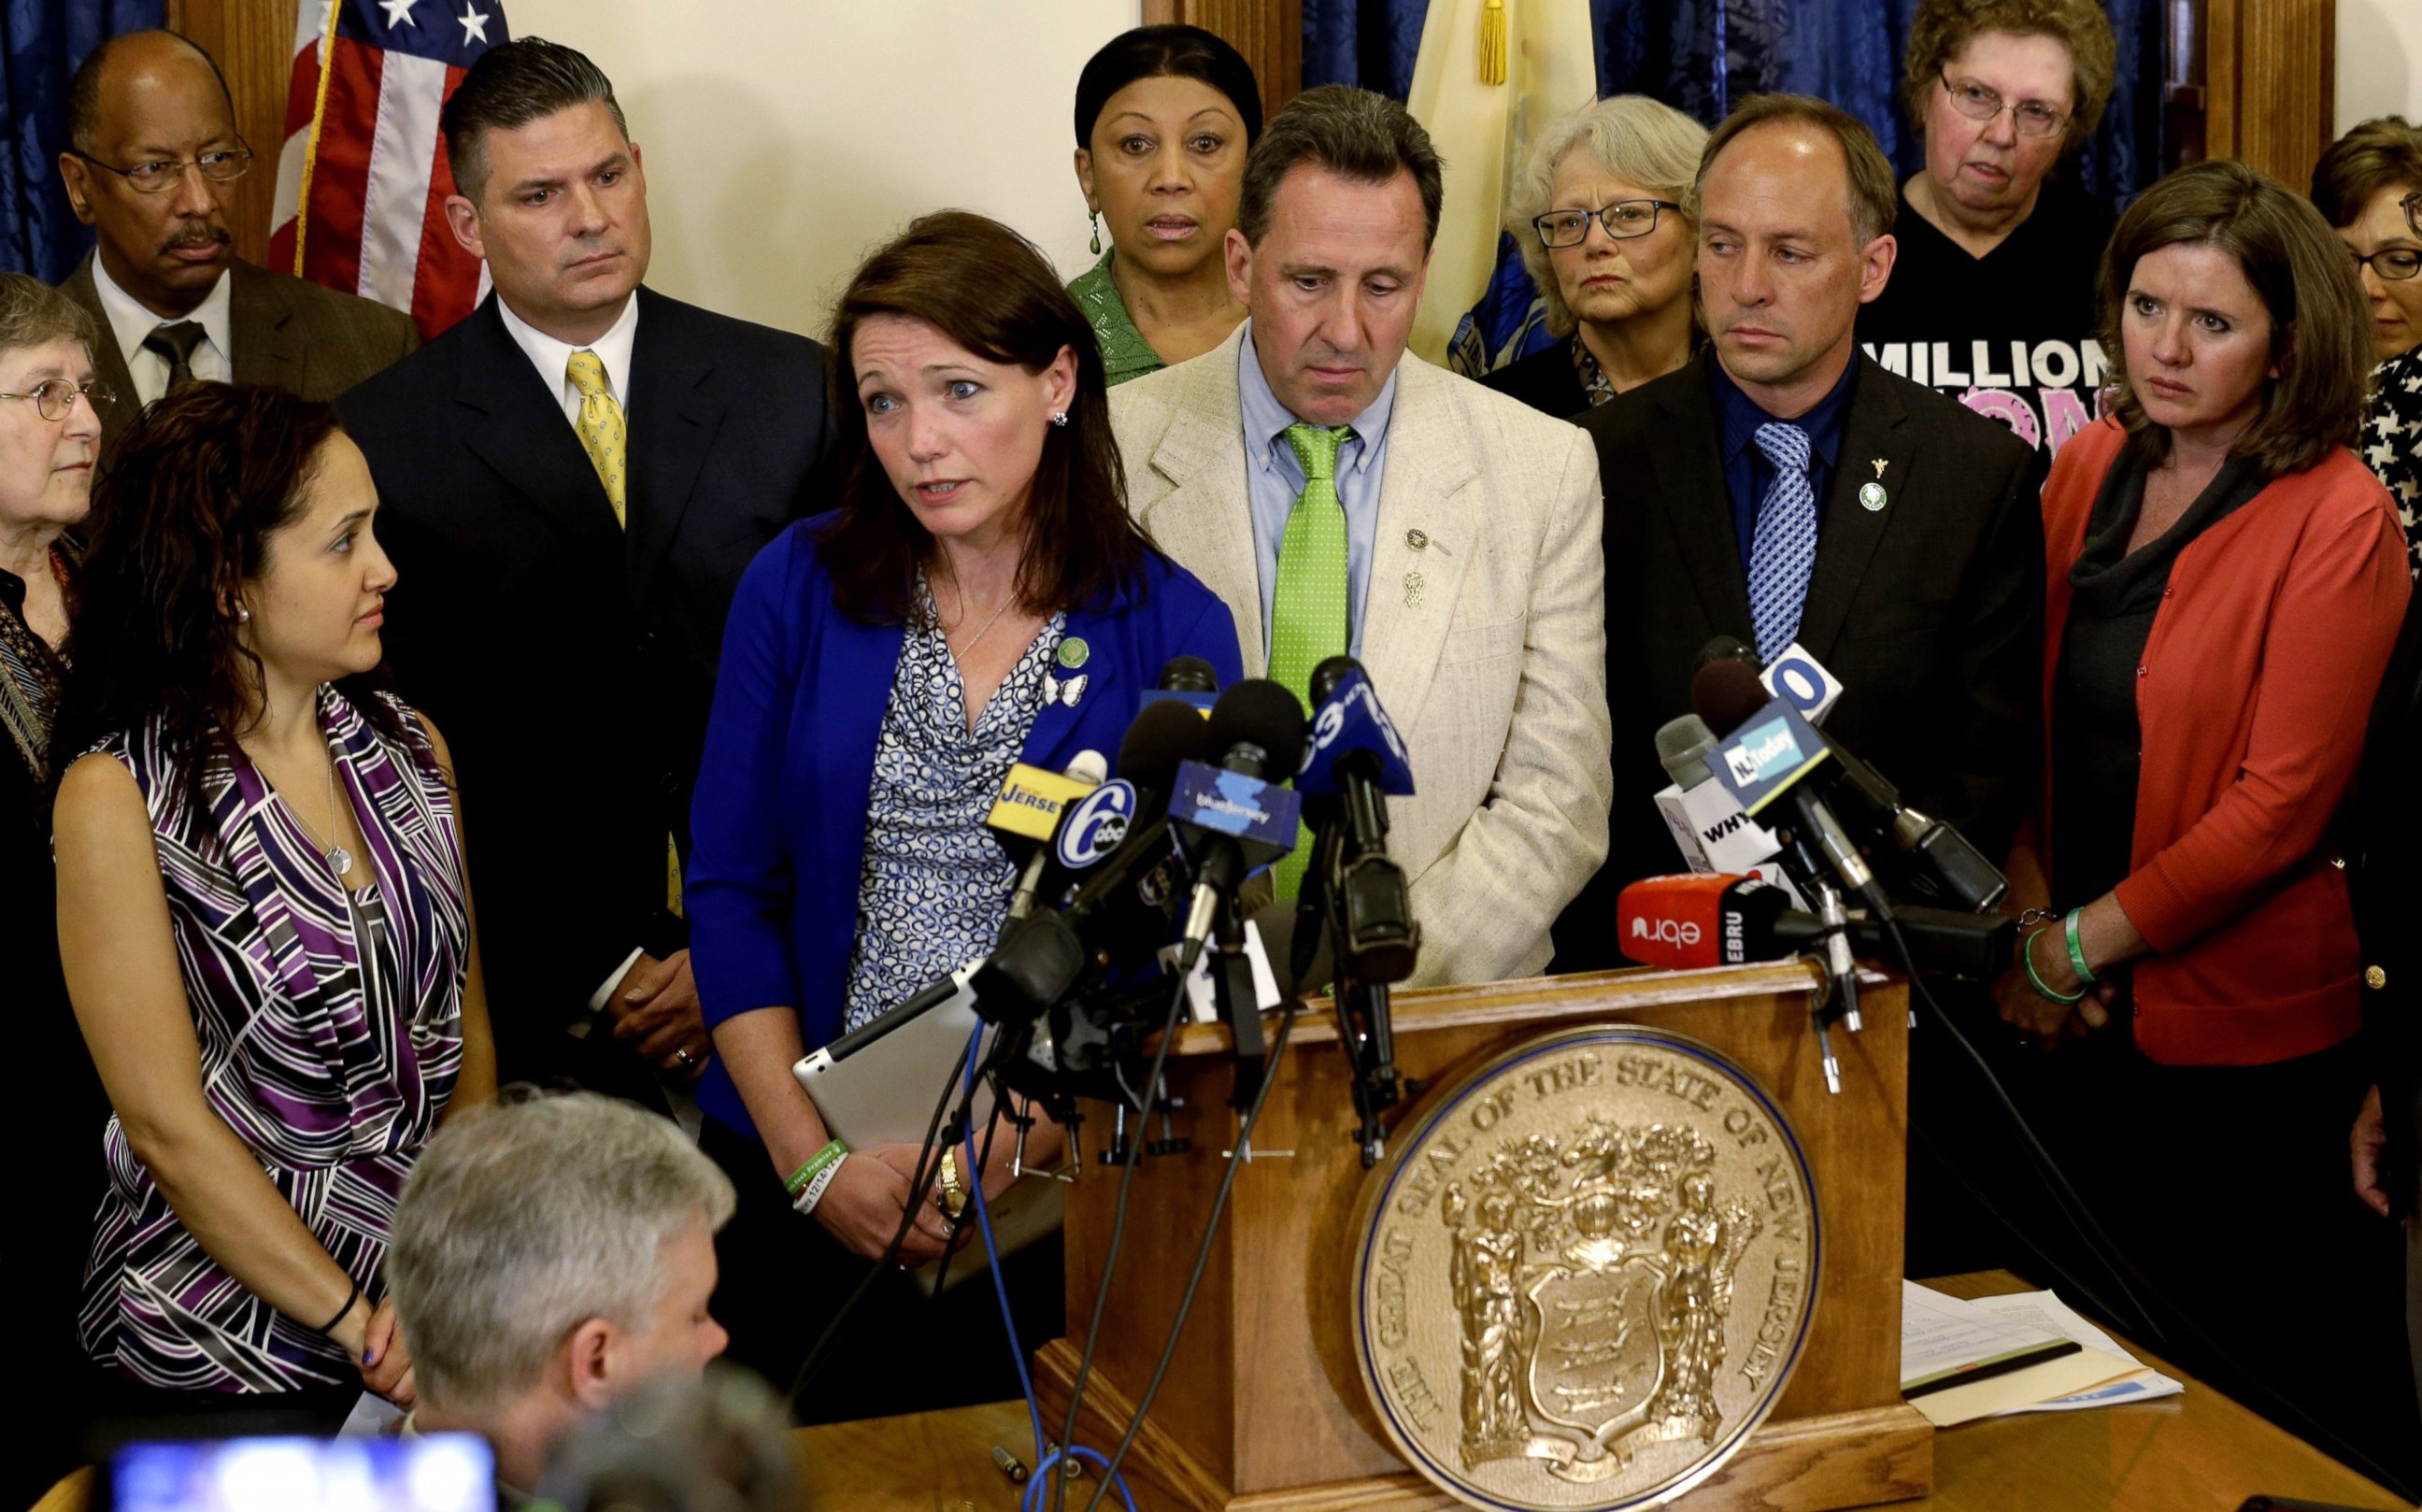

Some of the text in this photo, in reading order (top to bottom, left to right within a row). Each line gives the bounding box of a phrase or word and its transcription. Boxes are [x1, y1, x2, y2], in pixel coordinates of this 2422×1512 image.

[1315, 701, 1345, 749] 3
[1001, 783, 1065, 815] JERSE
[1063, 784, 1126, 863] 6
[1092, 822, 1125, 843] abc
[1726, 910, 1745, 963] EBRU
[1378, 1052, 1802, 1433] THE GREAT SEAL OF THE STATE OF NEW JERSEY
